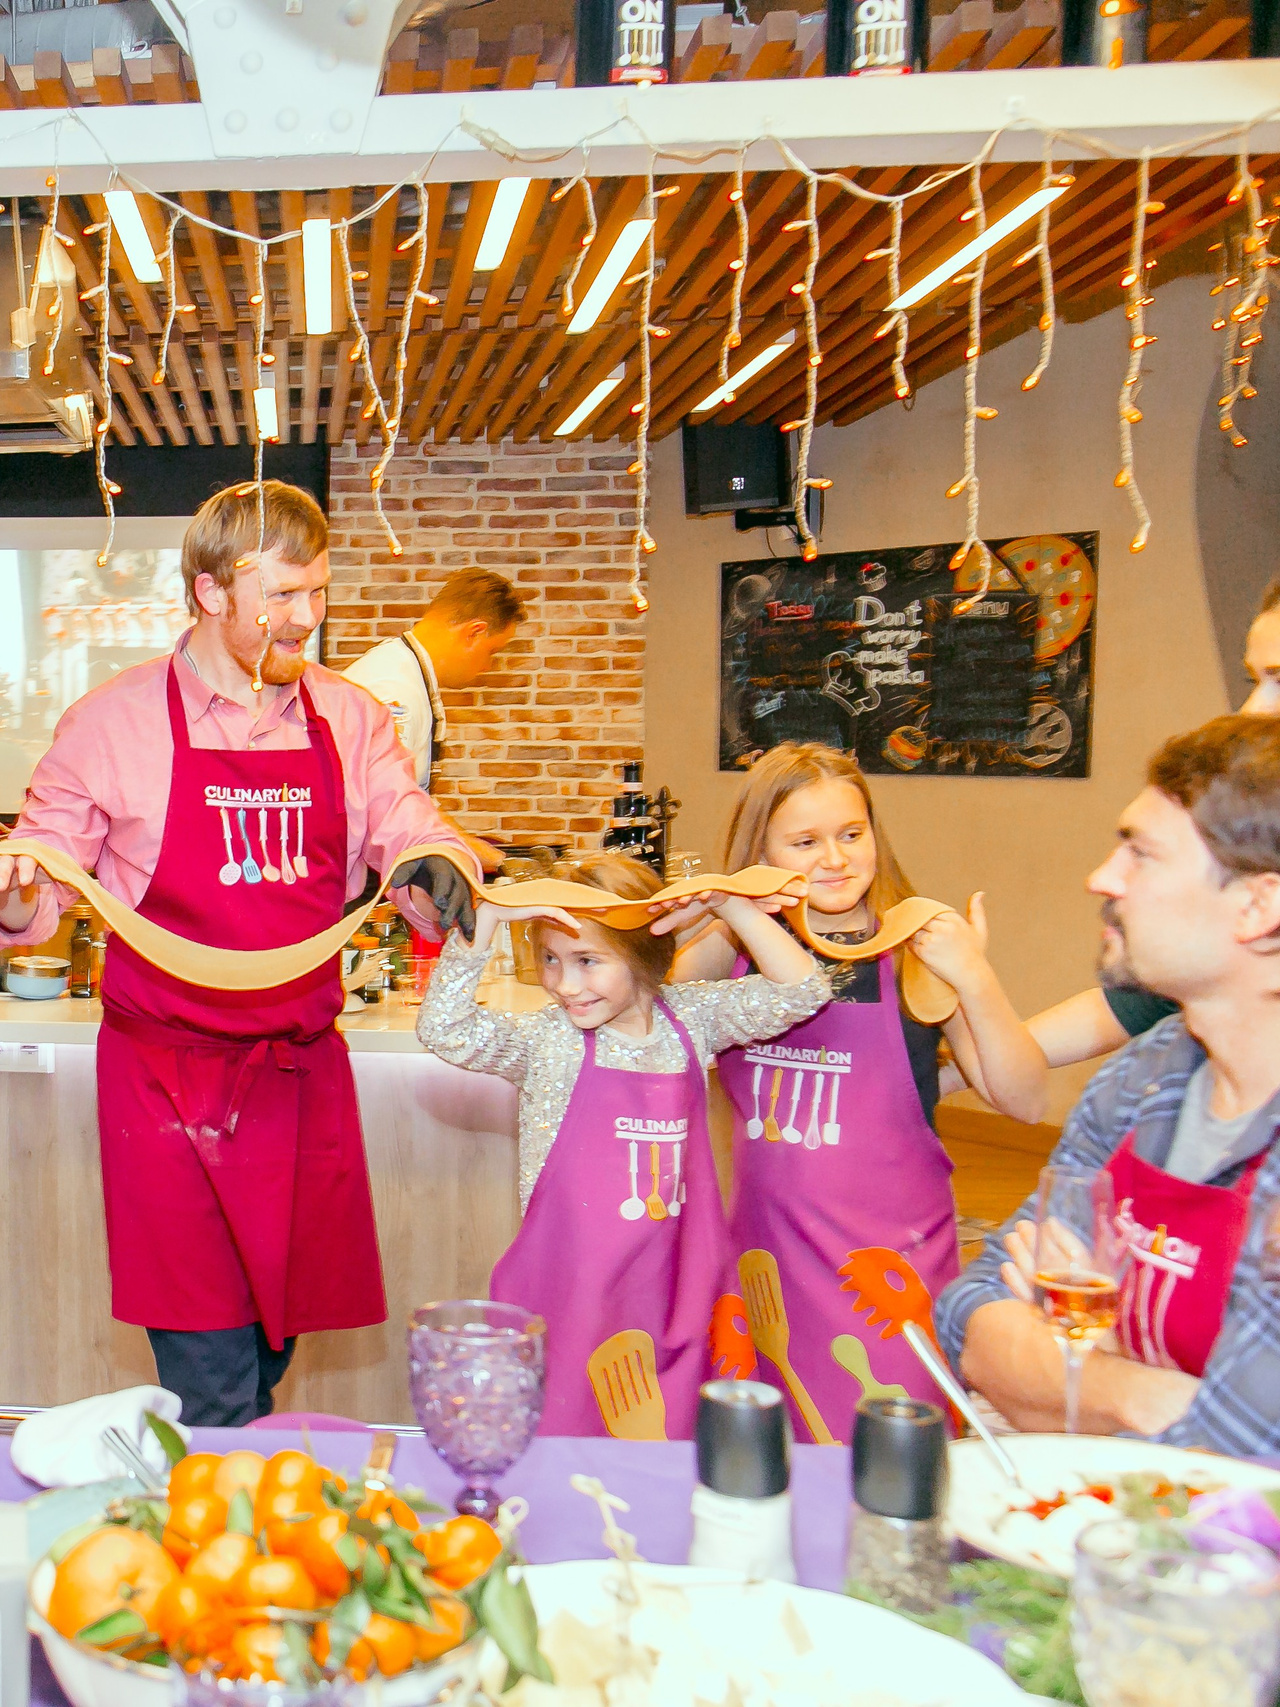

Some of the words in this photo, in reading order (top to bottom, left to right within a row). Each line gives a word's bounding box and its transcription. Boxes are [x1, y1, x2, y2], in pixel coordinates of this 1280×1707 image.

[621, 0, 664, 23] ON
[858, 0, 905, 23] ON
[952, 598, 1010, 616] enu
[854, 644, 909, 666] make
[865, 664, 925, 690] pasta
[614, 1116, 688, 1133] CULINAR
